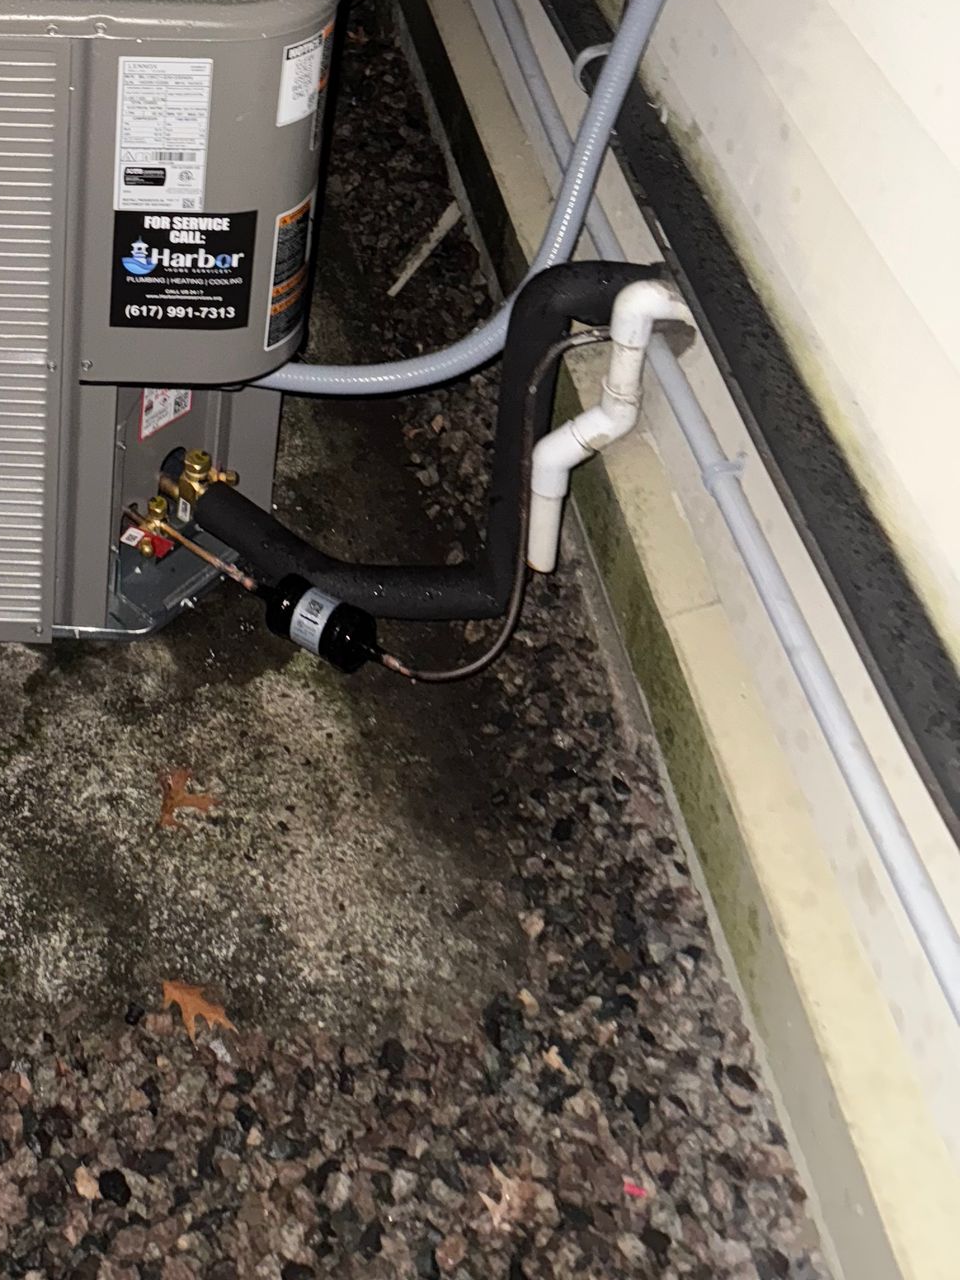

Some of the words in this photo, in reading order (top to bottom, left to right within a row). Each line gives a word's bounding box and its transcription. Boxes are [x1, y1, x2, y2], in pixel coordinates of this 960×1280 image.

[144, 216, 171, 229] FOR
[172, 217, 231, 231] SERVICE
[169, 230, 207, 244] CALL:
[151, 248, 245, 268] Harbor
[126, 275, 166, 284] PLUMBING
[171, 276, 204, 285] HEATING
[209, 277, 243, 285] COOLING
[125, 304, 163, 320] (617)
[166, 306, 236, 319] 991-7313
